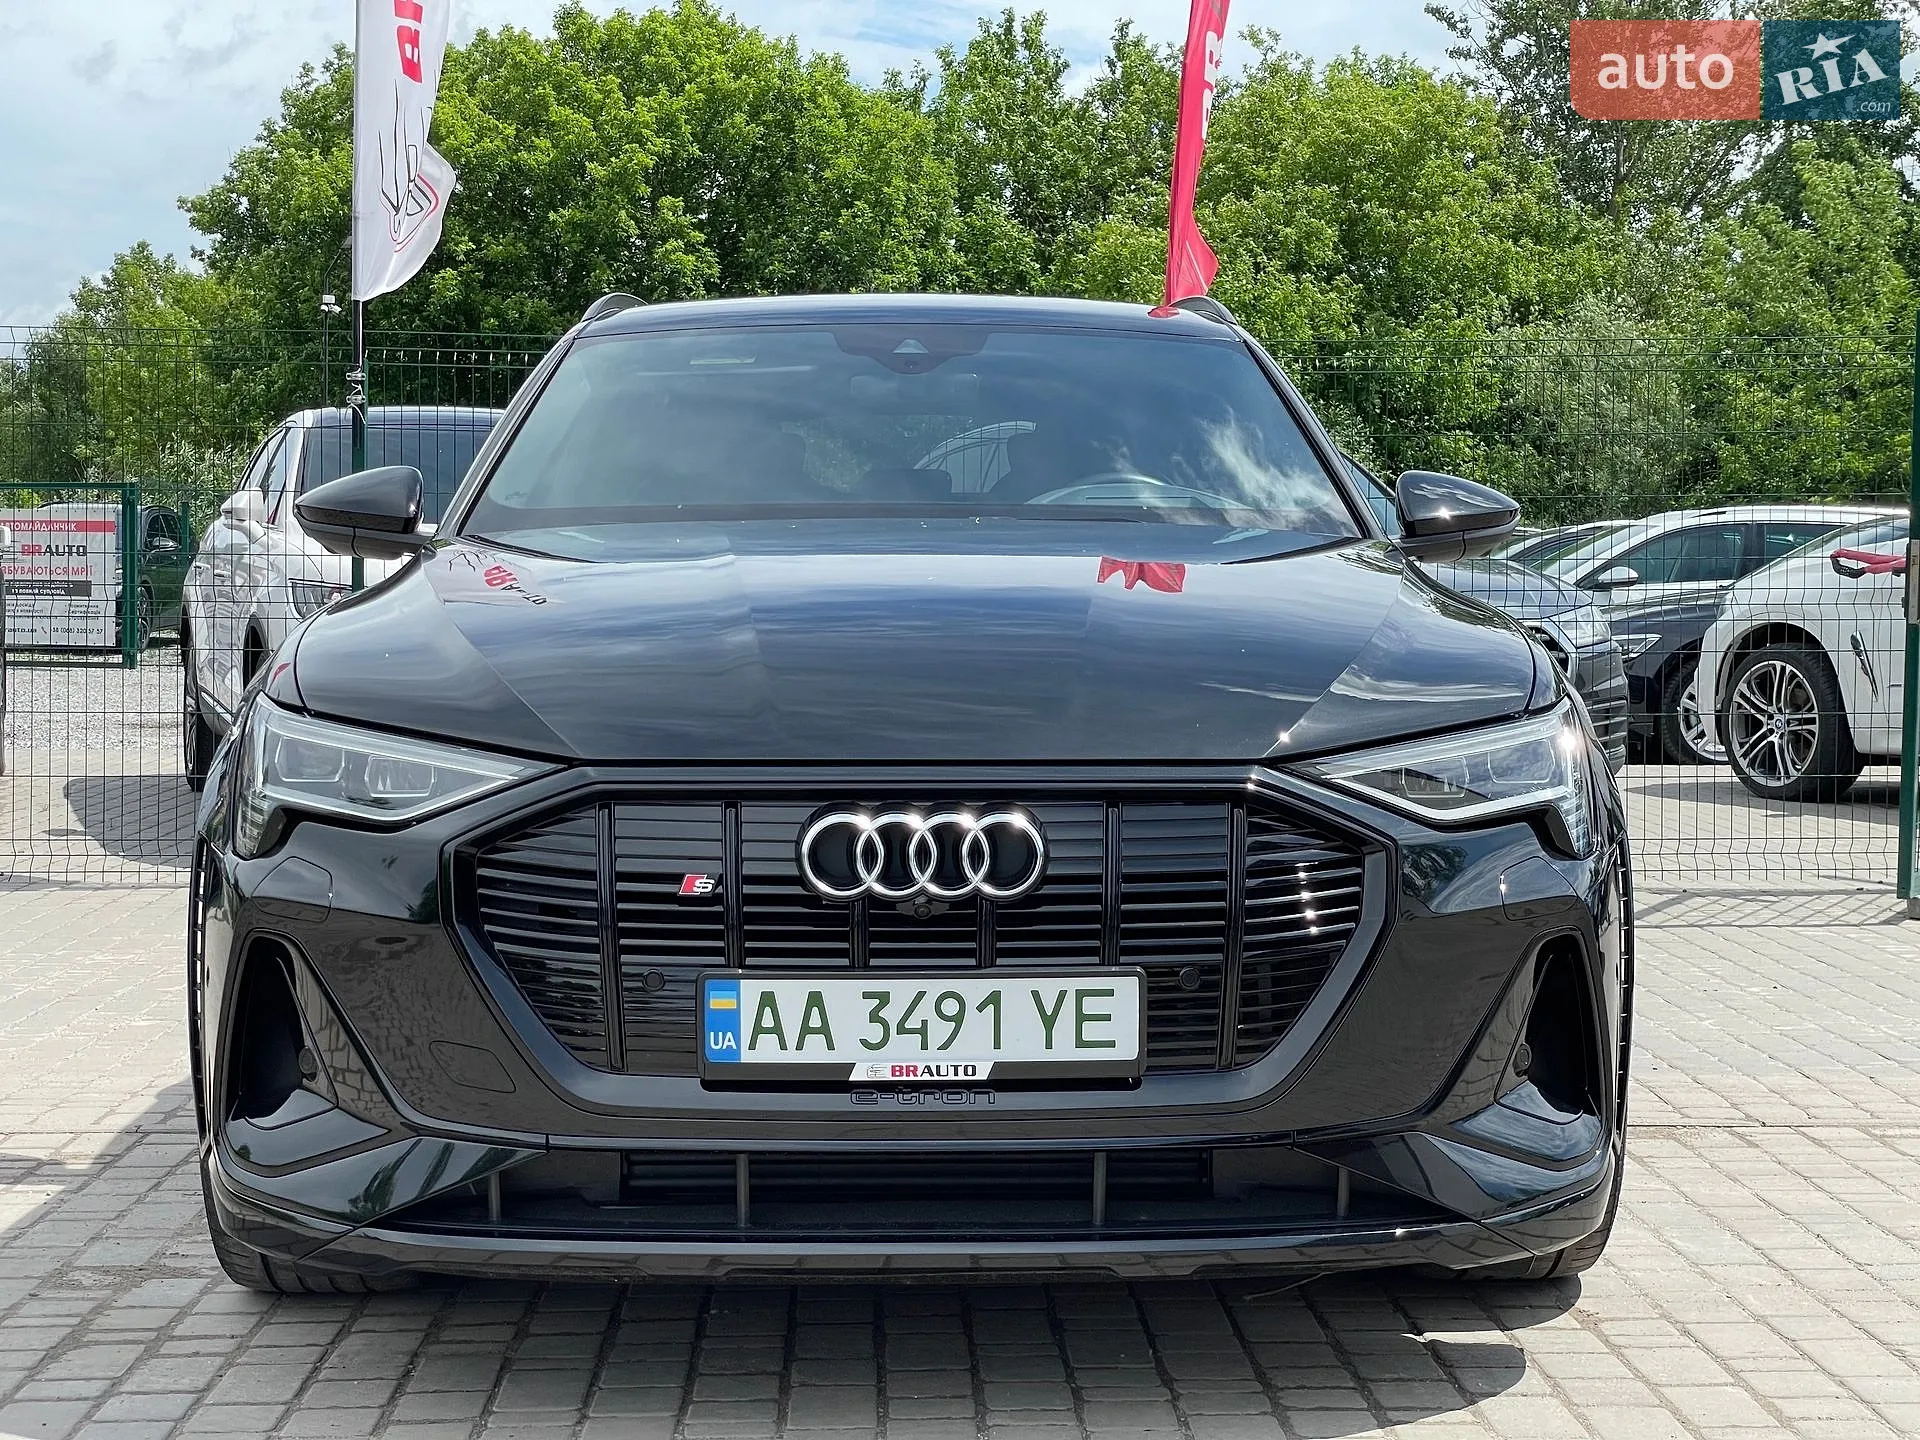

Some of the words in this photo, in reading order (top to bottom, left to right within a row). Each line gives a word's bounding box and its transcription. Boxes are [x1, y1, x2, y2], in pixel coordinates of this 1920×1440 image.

[0, 521, 77, 531] ВТОМАЙДАНЧИК
[21, 544, 88, 557] BRAUTO
[71, 565, 93, 577] МРЇ
[692, 879, 716, 893] S
[709, 1031, 737, 1050] UA
[747, 990, 836, 1051] AA
[858, 990, 1003, 1051] 3491
[1030, 988, 1117, 1050] YE
[890, 1064, 977, 1078] BRAUTO
[850, 1086, 996, 1105] e-tron
